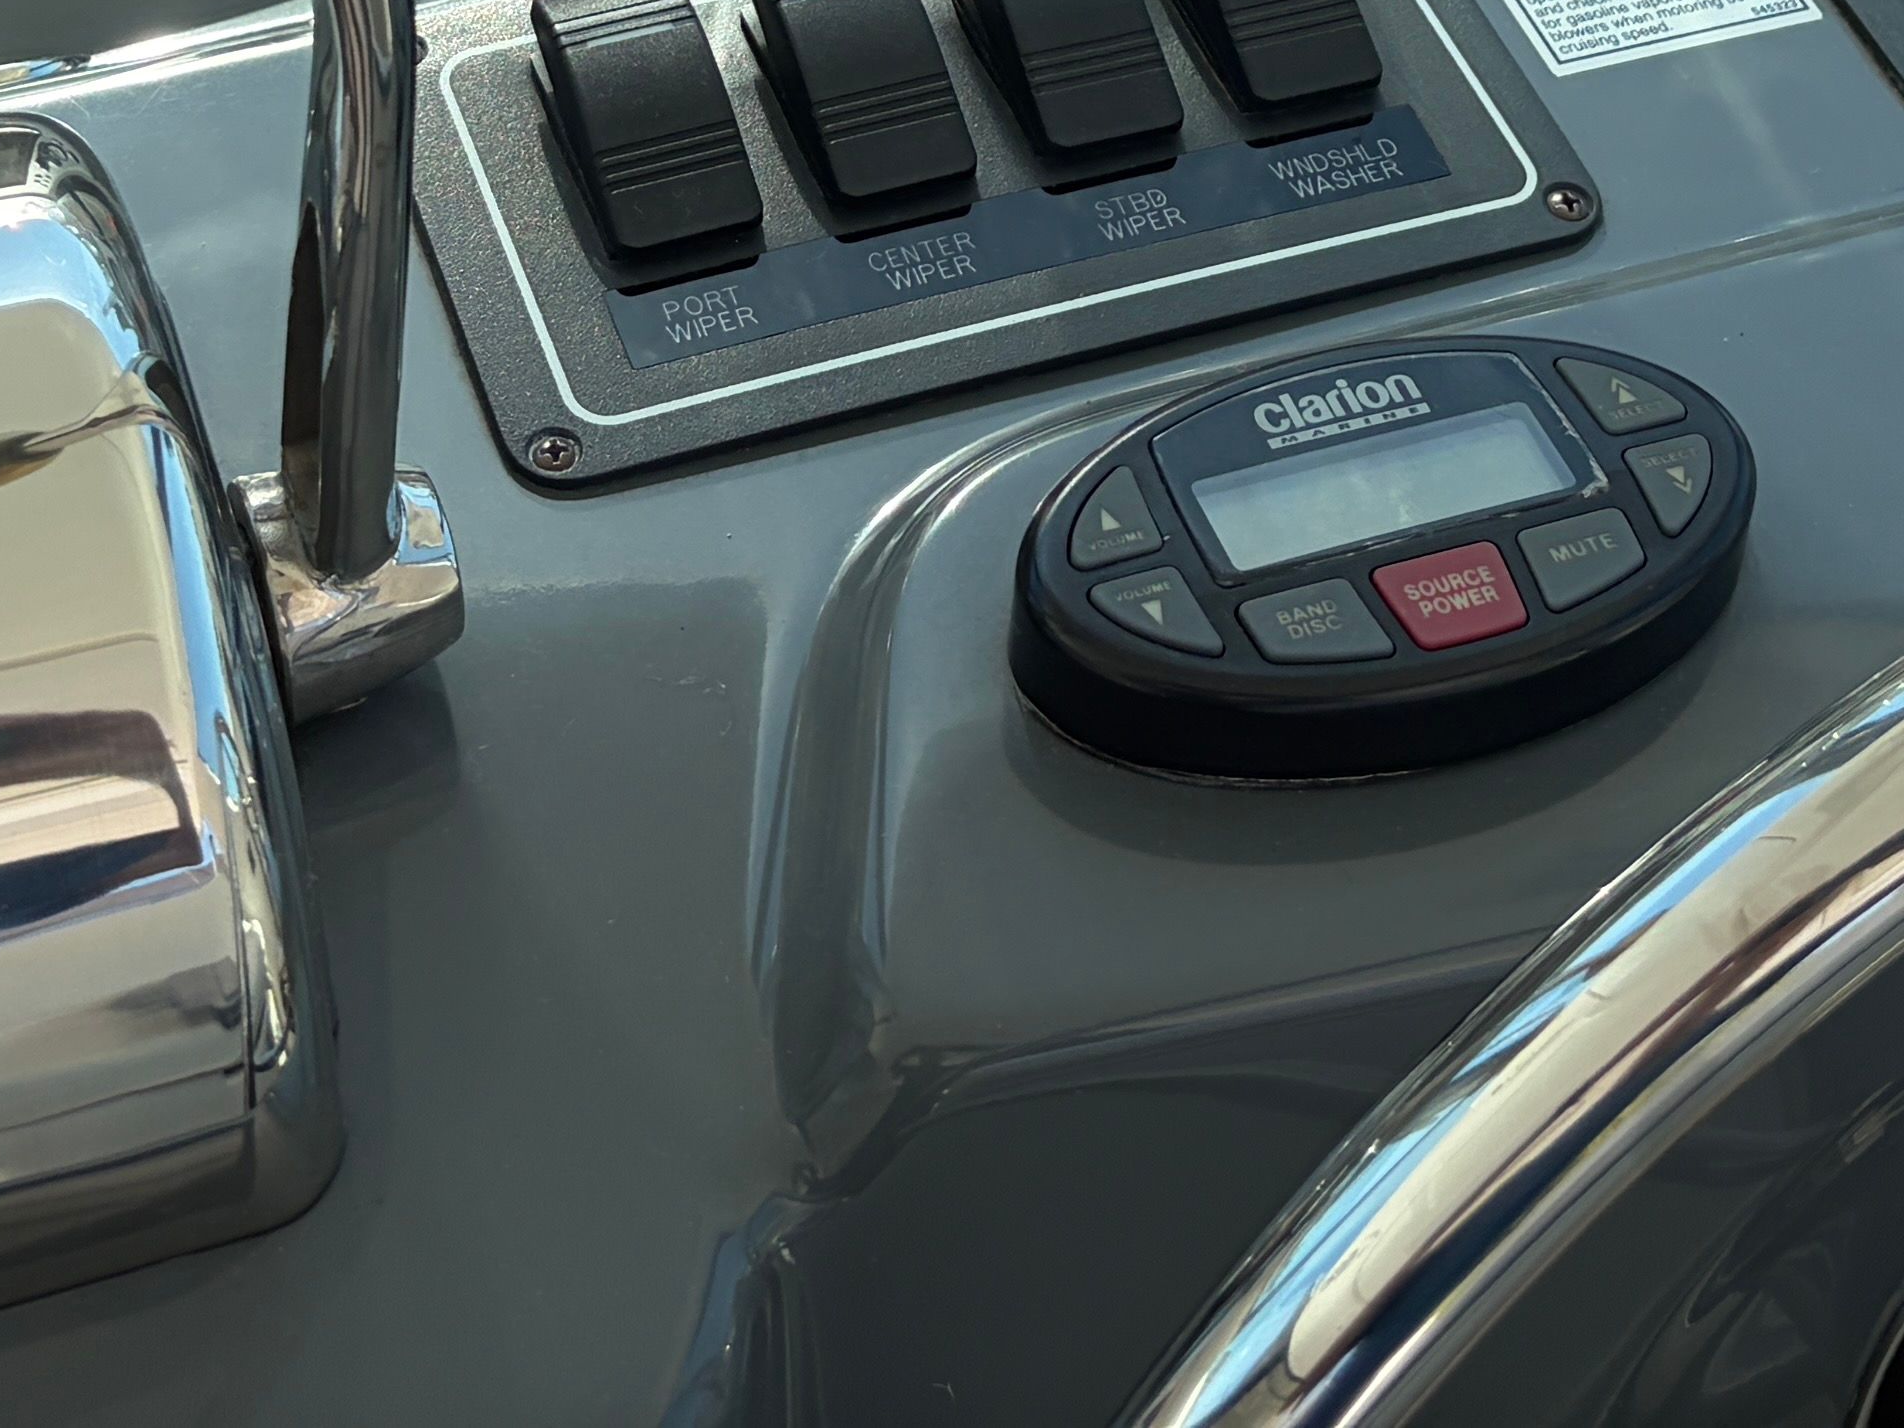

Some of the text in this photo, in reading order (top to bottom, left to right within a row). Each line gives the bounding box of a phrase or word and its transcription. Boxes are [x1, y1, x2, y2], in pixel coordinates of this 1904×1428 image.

[1269, 138, 1398, 182] WNDSHLD
[1288, 160, 1404, 199] WASHER
[1095, 188, 1167, 221] STBD
[1097, 207, 1186, 241] WIPER
[868, 231, 976, 273] CENTER
[885, 254, 976, 291] WIPER
[661, 285, 739, 321] PORT
[666, 307, 758, 344] WIPER
[1280, 404, 1424, 445] MARINE
[1548, 532, 1617, 563] MUTE
[1115, 579, 1172, 602] VOLUME
[1403, 564, 1494, 602] SOURCE
[1276, 599, 1336, 625] BAND
[1418, 586, 1501, 618] POWER
[1286, 613, 1342, 639] DISC
